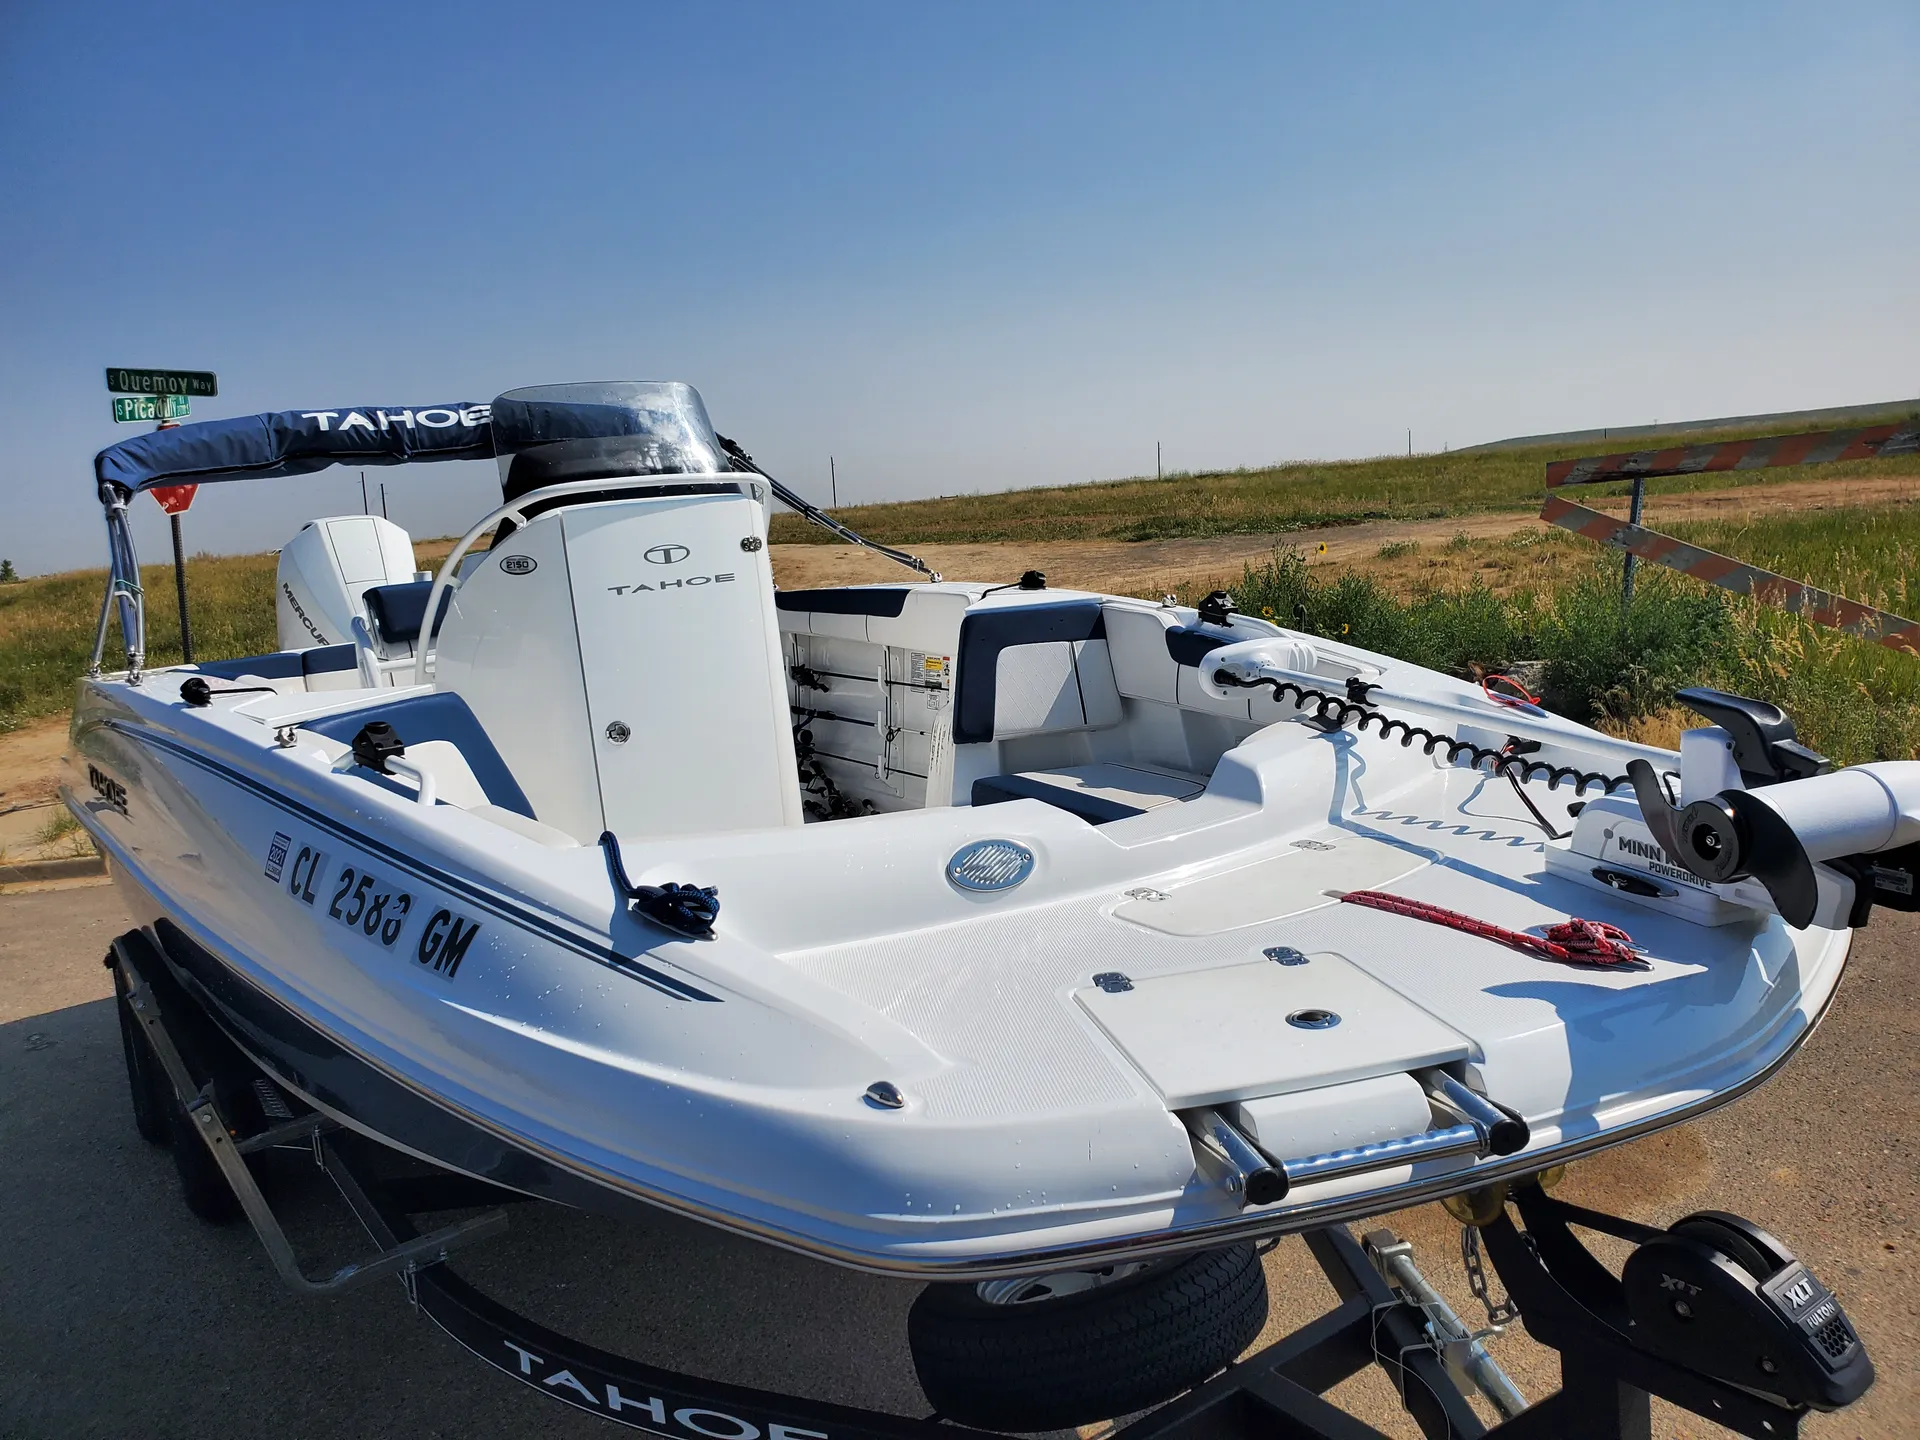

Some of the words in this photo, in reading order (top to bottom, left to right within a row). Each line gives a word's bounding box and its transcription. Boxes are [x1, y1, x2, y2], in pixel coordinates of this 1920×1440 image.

[119, 370, 188, 393] Quemoy
[192, 378, 212, 392] Way
[117, 404, 123, 415] S
[302, 404, 493, 431] TAHOE
[506, 560, 530, 569] 2150
[607, 572, 736, 596] TAHOE
[1618, 836, 1661, 862] MINN
[1648, 860, 1712, 888] POWERDRIVE
[290, 846, 321, 905] CL
[418, 909, 480, 978] GM
[1784, 1277, 1815, 1309] XLT
[1806, 1301, 1836, 1329] FULTON
[504, 1340, 828, 1440] TAHOE
